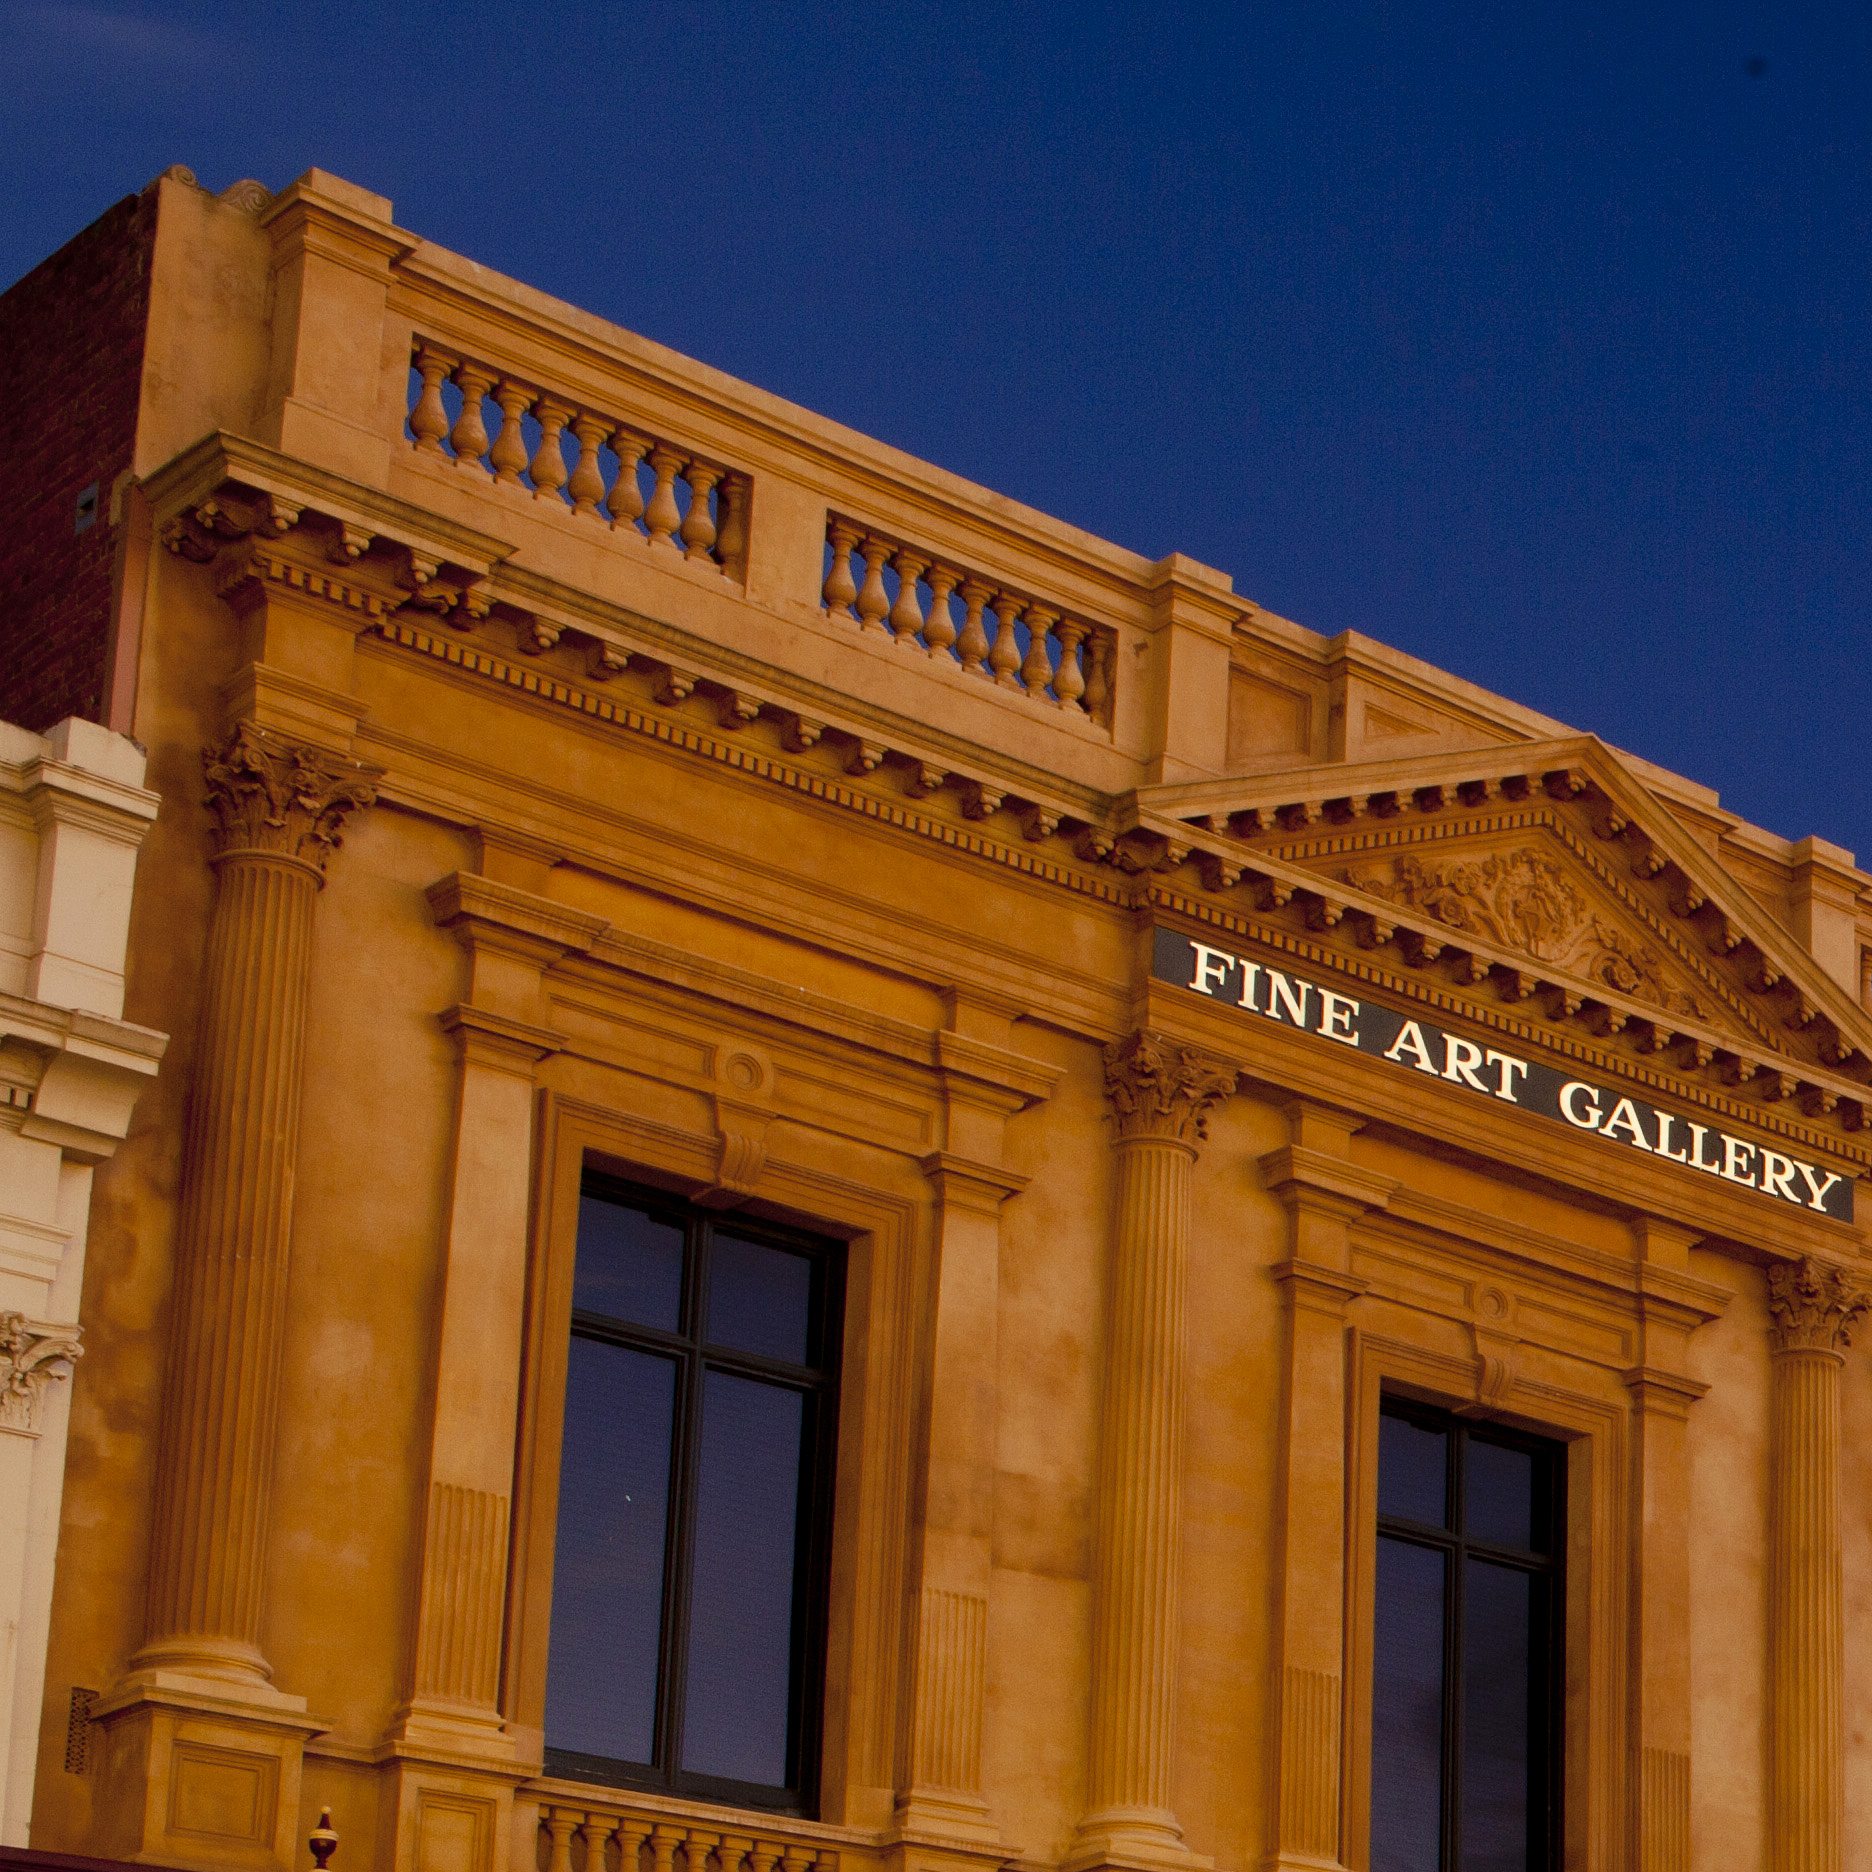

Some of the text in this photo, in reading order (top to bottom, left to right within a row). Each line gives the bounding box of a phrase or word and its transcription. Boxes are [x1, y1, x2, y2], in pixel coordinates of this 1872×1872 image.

[1188, 941, 1843, 1213] FINE ART GALLERY
